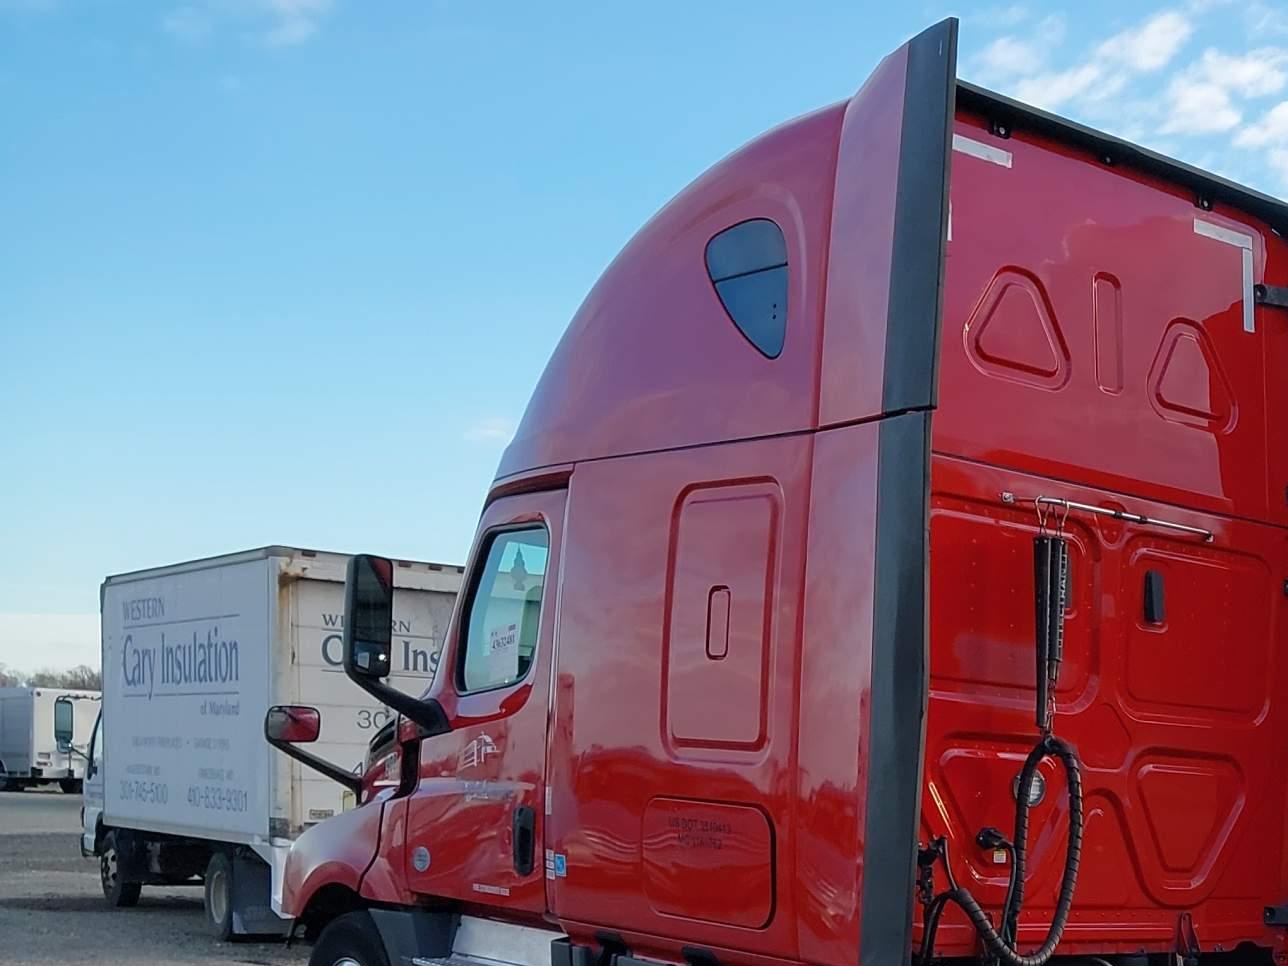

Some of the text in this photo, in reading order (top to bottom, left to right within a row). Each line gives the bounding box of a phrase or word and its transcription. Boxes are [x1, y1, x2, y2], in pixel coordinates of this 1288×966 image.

[122, 596, 165, 621] WESTERN
[123, 625, 239, 701] Cary Insulation
